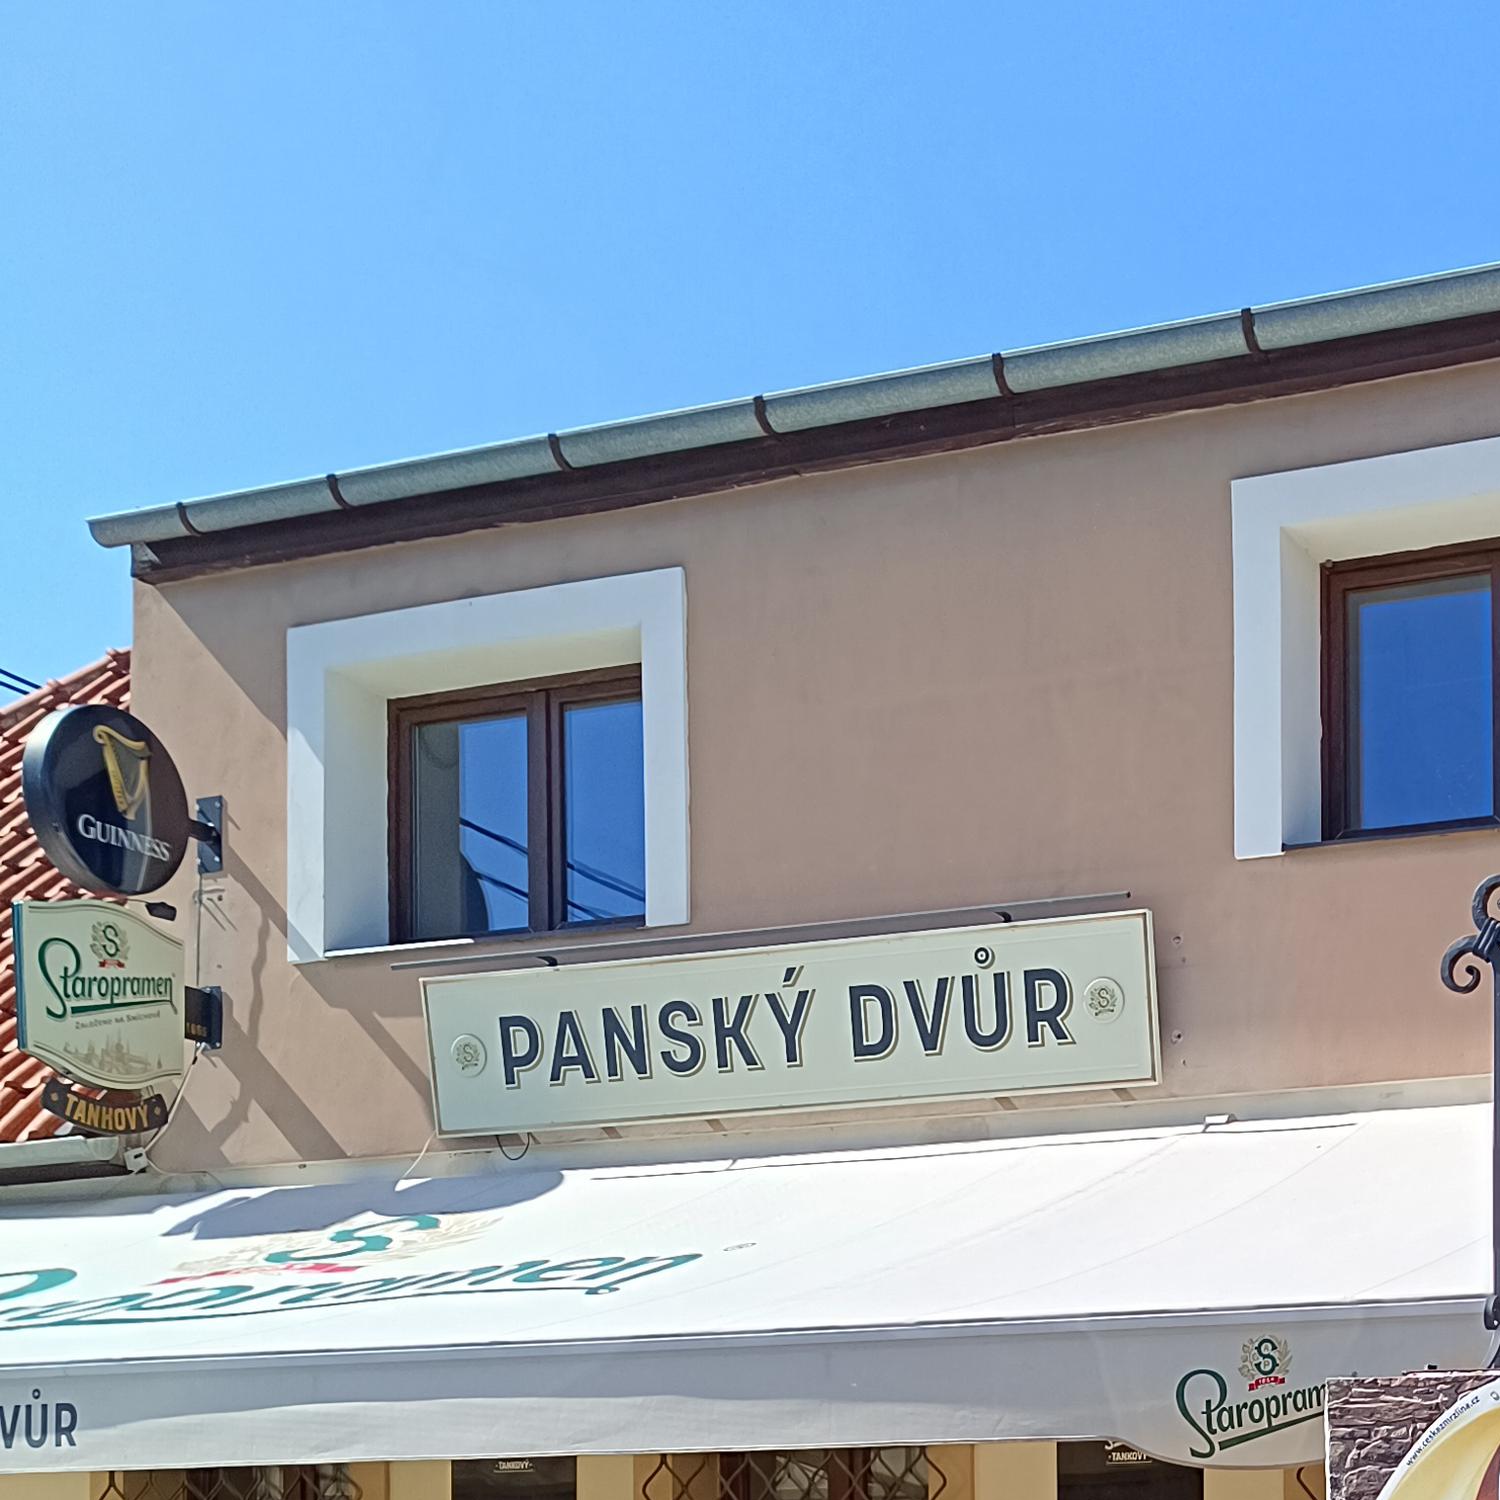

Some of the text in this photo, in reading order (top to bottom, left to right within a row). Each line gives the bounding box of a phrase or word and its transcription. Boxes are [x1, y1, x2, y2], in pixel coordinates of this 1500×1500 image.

[78, 813, 171, 862] GUINNESS
[38, 937, 177, 1019] Staropramen
[498, 946, 1078, 1090] PANSKÝ DVŮR
